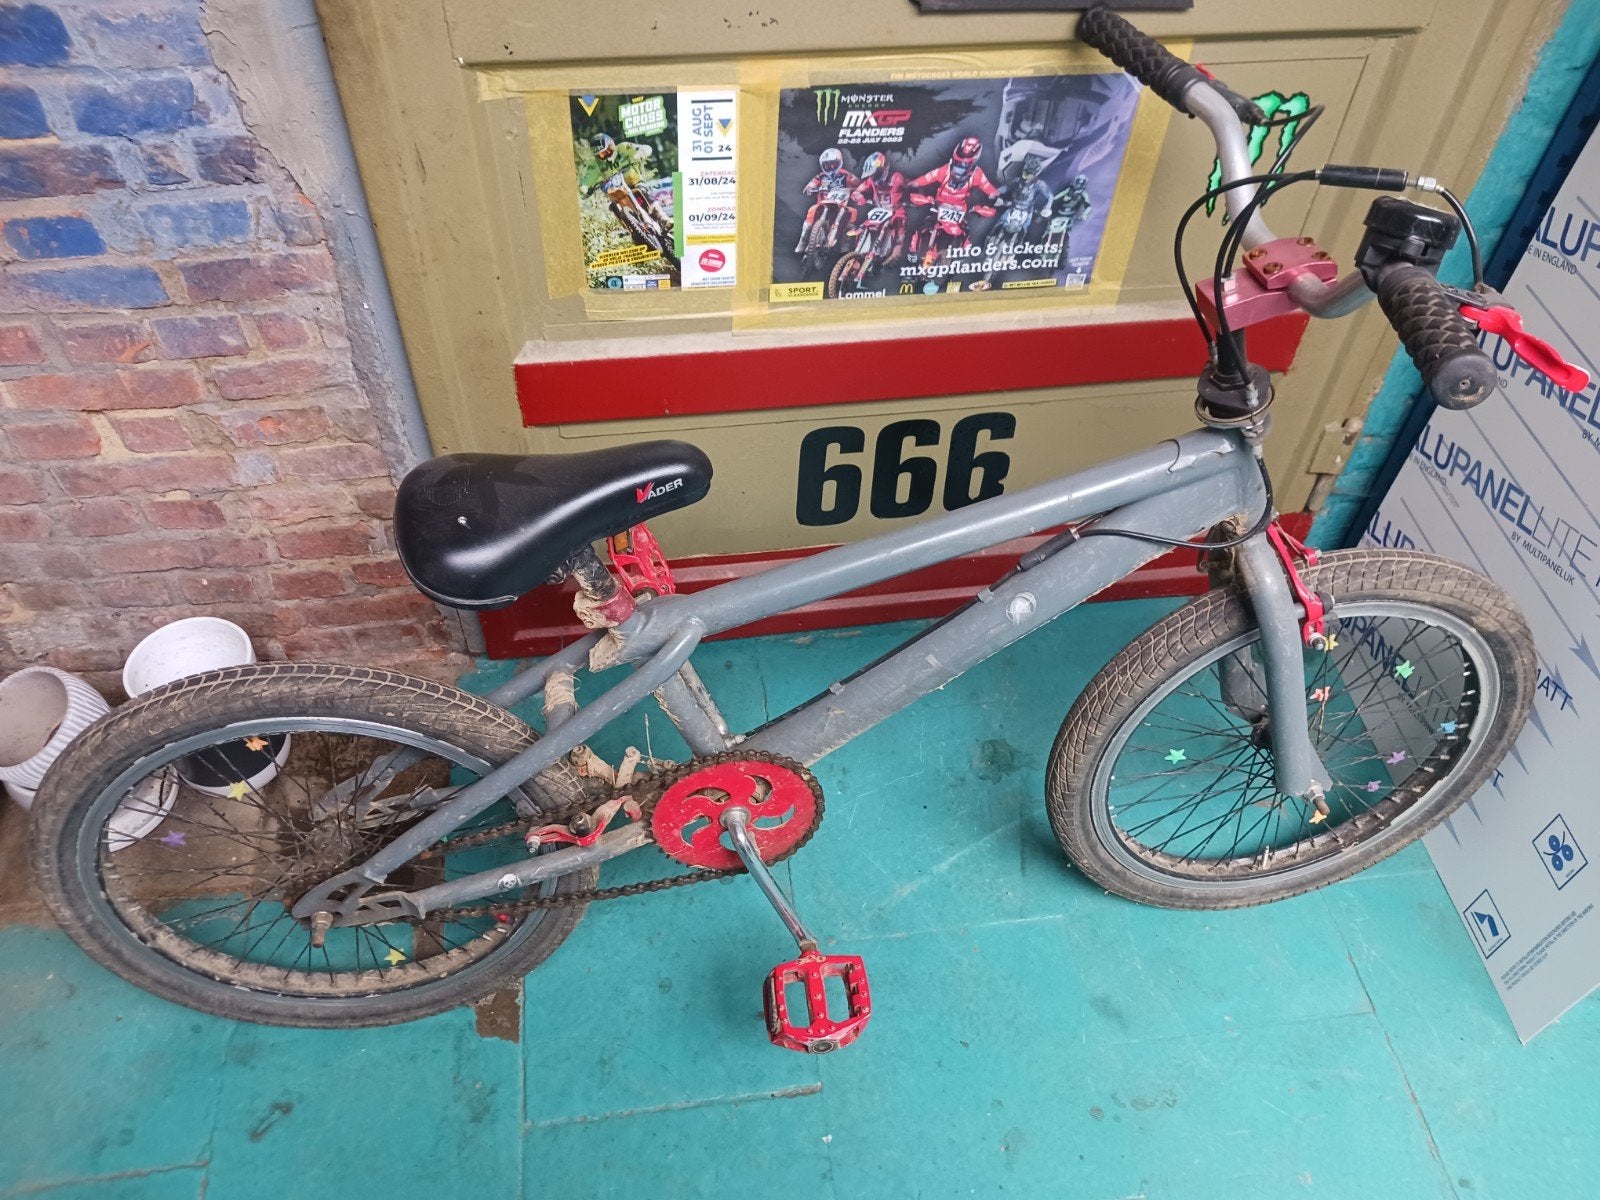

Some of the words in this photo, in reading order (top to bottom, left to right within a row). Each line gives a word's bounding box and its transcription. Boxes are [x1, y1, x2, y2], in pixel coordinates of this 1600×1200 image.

[841, 93, 894, 103] MONSTER
[620, 98, 661, 118] MOTOR
[624, 108, 664, 129] CROSS
[692, 107, 702, 136] AUG
[703, 105, 713, 137] SEPT
[842, 109, 912, 127] MXGP
[838, 127, 905, 138] FLANDERS
[692, 140, 702, 152] 31
[703, 141, 713, 154] 01
[717, 145, 732, 153] 24
[688, 177, 736, 187] 31/08/24
[688, 212, 736, 222] 01/09/24
[870, 211, 889, 221] 61
[945, 244, 982, 258] info
[985, 243, 998, 255] &
[900, 257, 1059, 278] mxgpflanders.com
[1533, 248, 1541, 259] IN
[1541, 251, 1577, 275] ENGLAND
[838, 289, 886, 299] Lommel
[796, 412, 1017, 526] 666
[636, 478, 683, 504] VADER
[1511, 531, 1521, 543] BY
[1522, 540, 1576, 586] MULTIPANELUK
